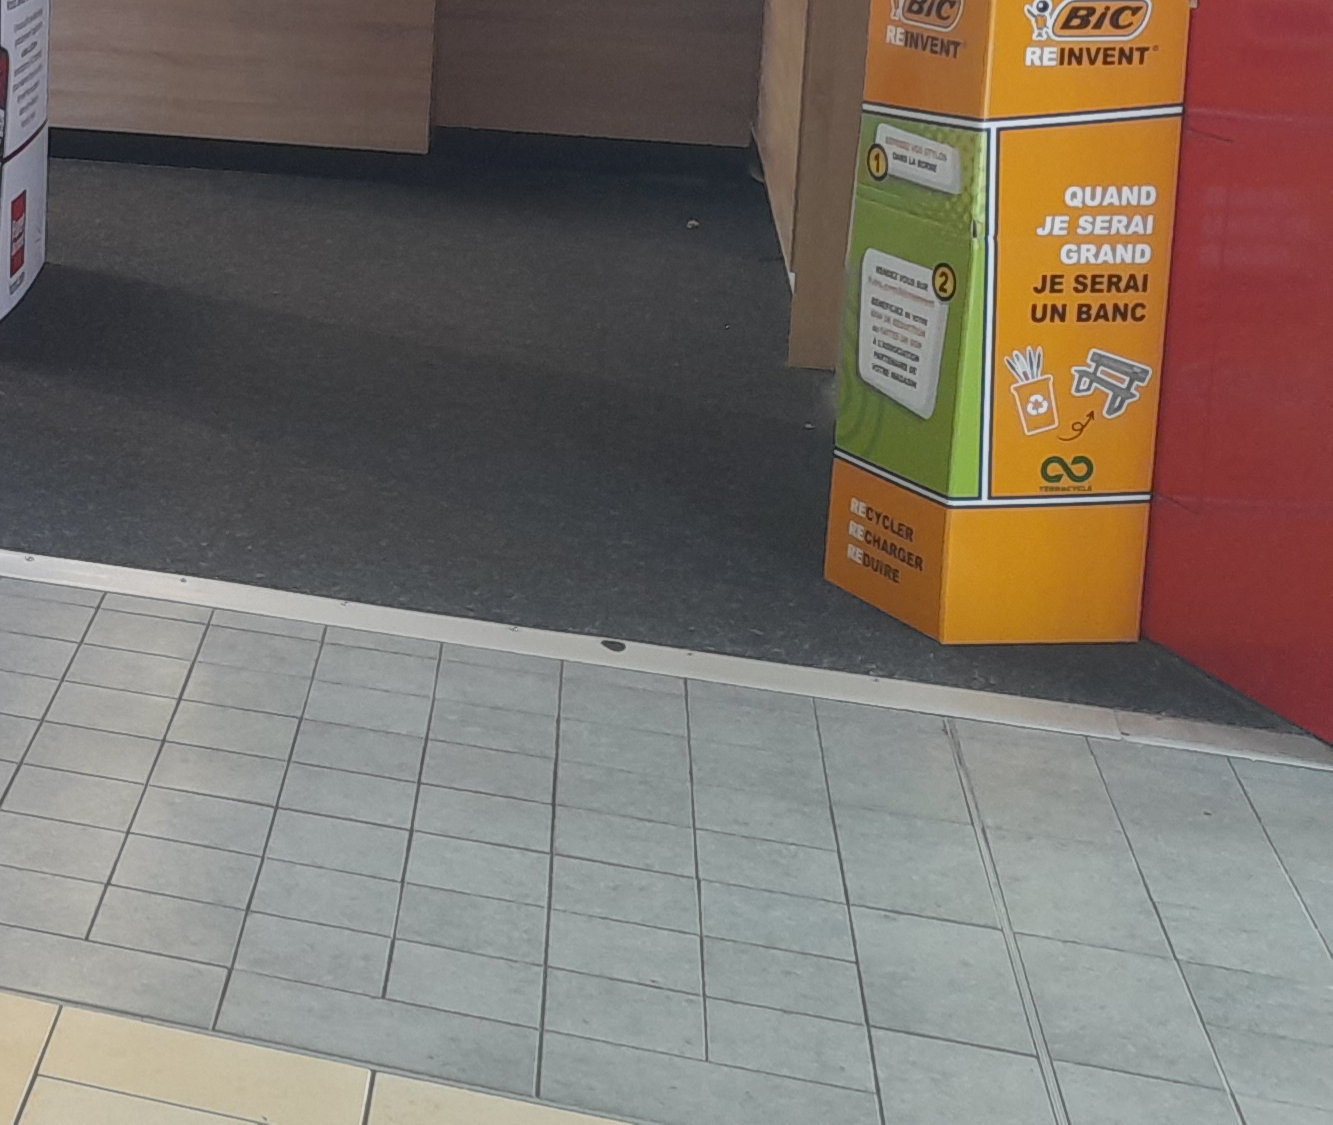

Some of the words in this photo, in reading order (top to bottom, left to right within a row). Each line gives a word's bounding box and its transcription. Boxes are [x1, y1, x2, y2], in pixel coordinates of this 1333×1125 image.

[886, 25, 962, 59] REINVENT
[1024, 46, 1150, 67] REINVENT
[874, 153, 881, 173] 1
[1065, 185, 1157, 207] QUAND
[1036, 215, 1069, 236] JE
[1077, 215, 1154, 236] SERAI
[1060, 244, 1152, 265] GRAND
[939, 271, 949, 294] 2
[1033, 274, 1068, 294] JE
[1072, 273, 1148, 293] SERAI
[1031, 303, 1067, 323] UN
[1076, 302, 1146, 323] BANC
[850, 497, 914, 543] RECYCLER
[848, 520, 924, 572] RECHARGER
